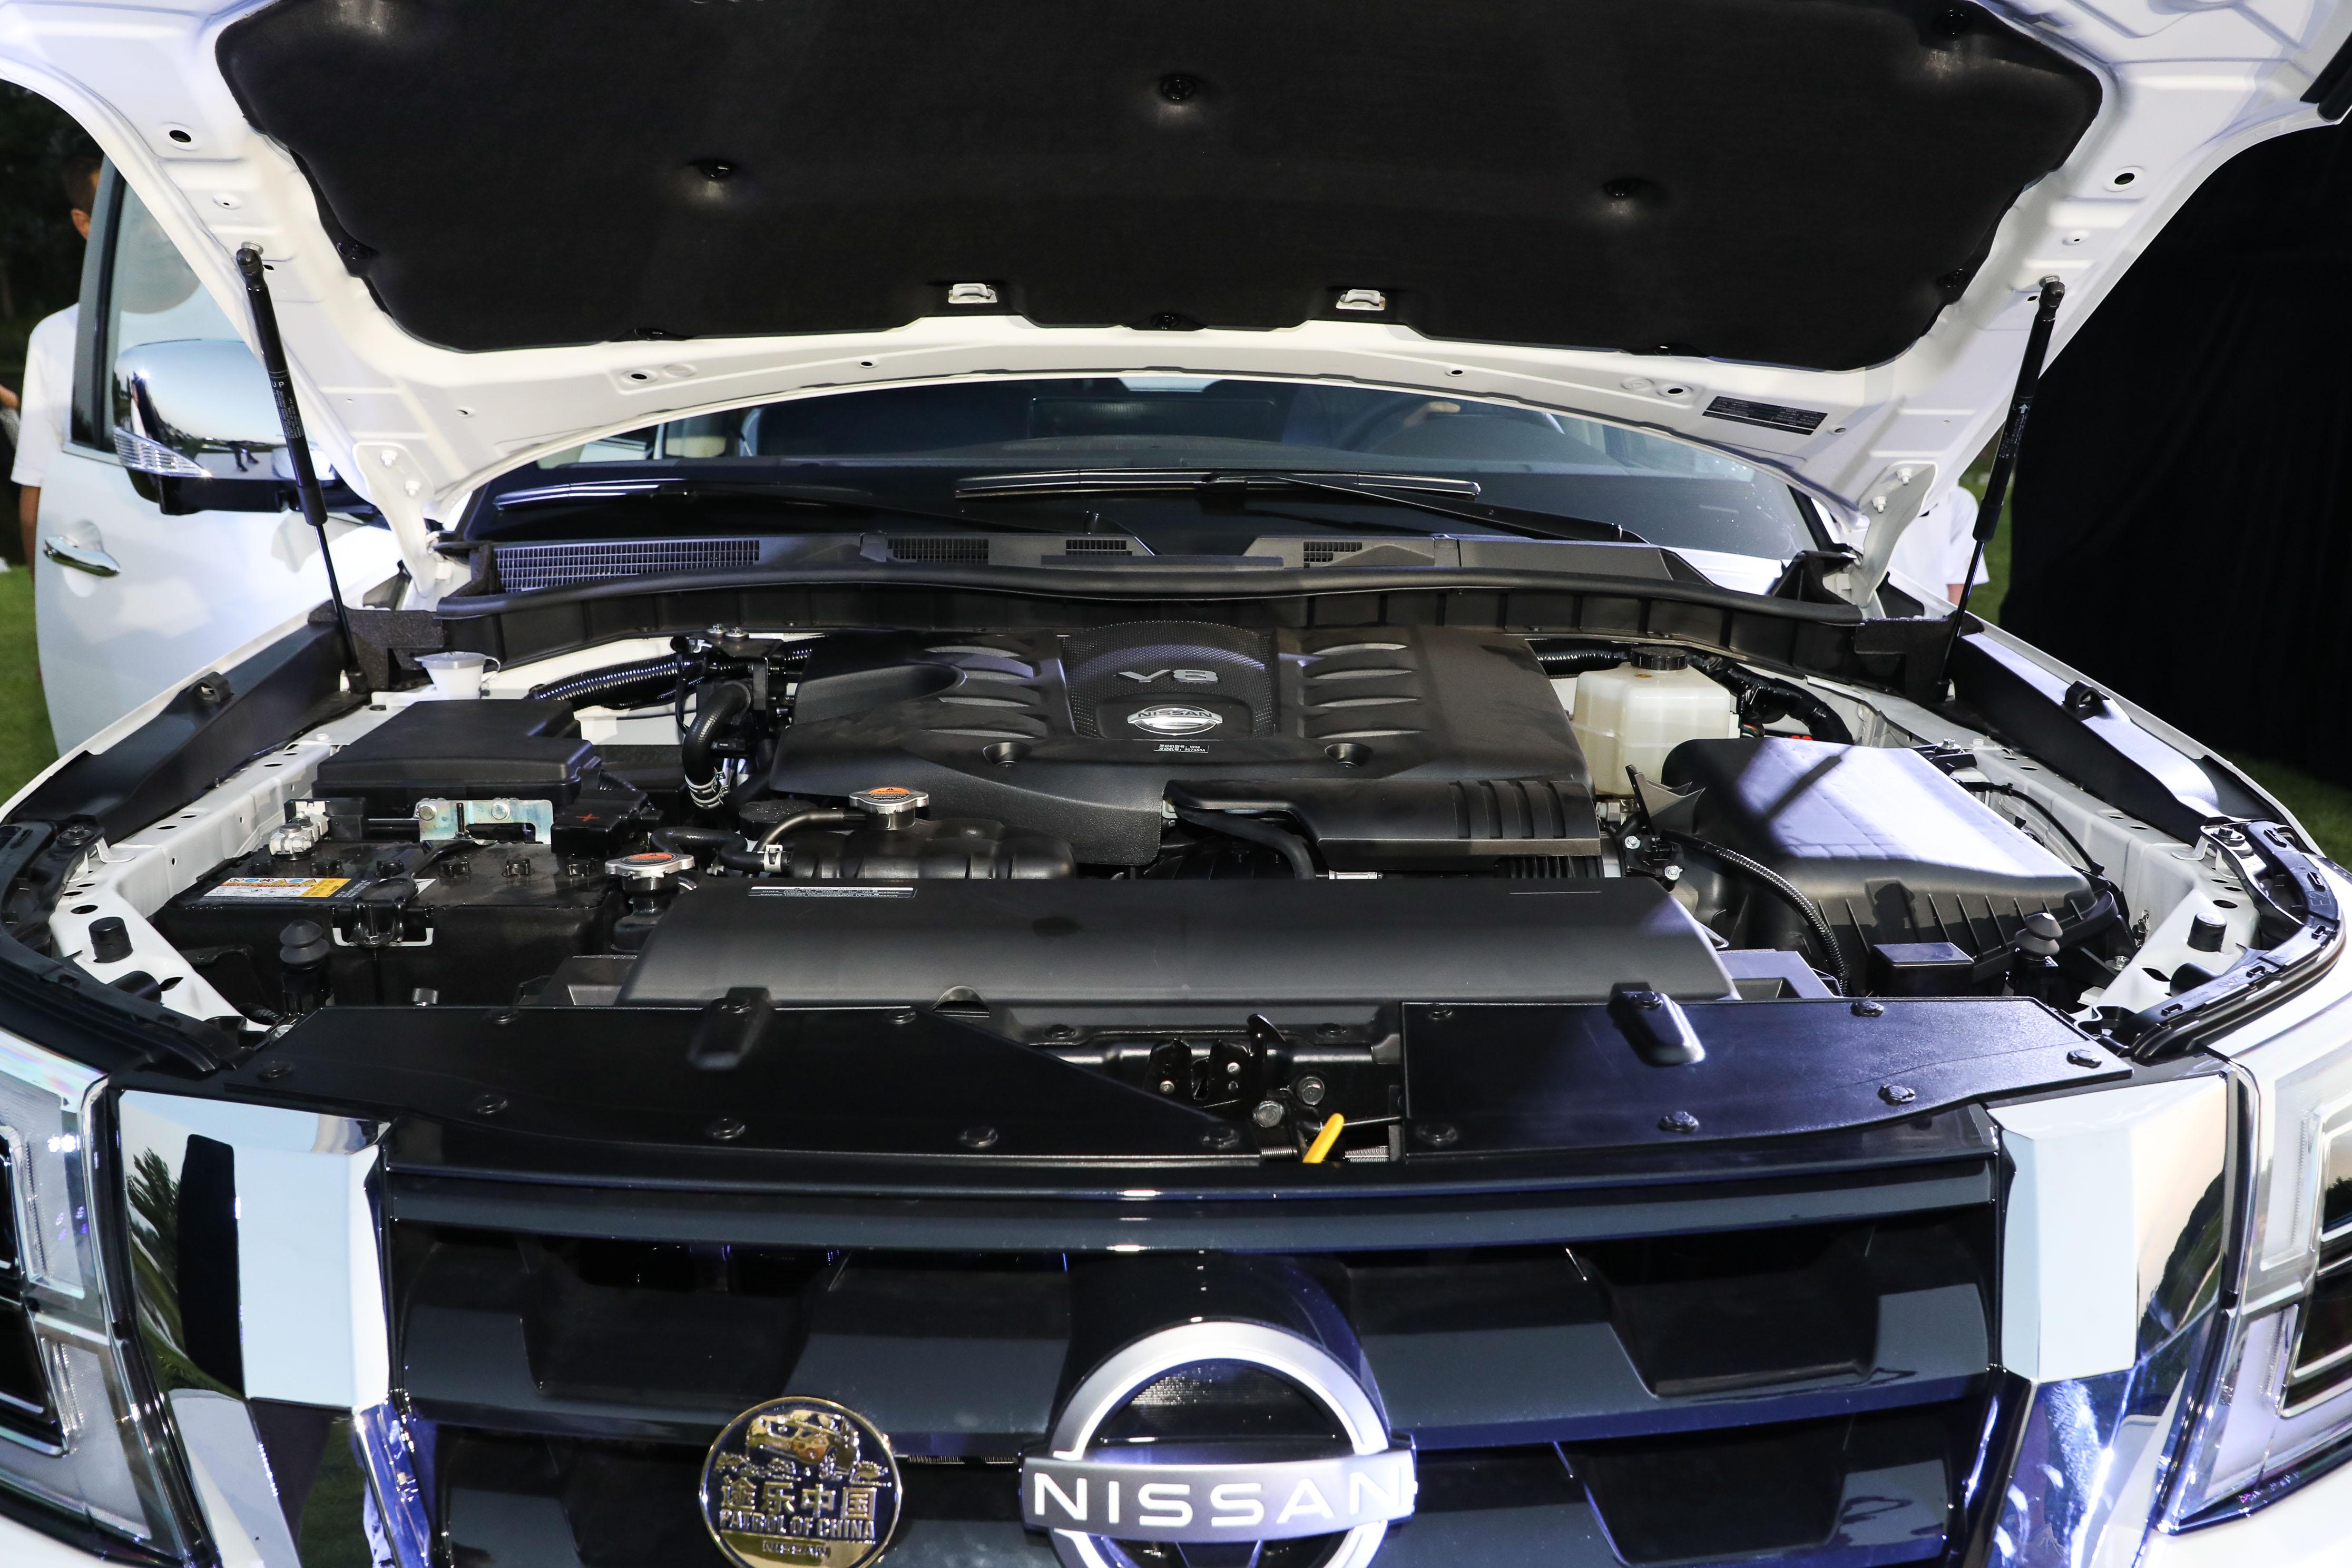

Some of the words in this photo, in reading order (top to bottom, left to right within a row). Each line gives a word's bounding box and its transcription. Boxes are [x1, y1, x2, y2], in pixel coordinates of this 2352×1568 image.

[1118, 669, 1219, 683] V8
[720, 1475, 878, 1522] 途乐中国
[1033, 1466, 1404, 1526] NISSAN
[720, 1508, 787, 1534] PATROL
[789, 1515, 815, 1536] OF
[818, 1518, 876, 1540] CHINA
